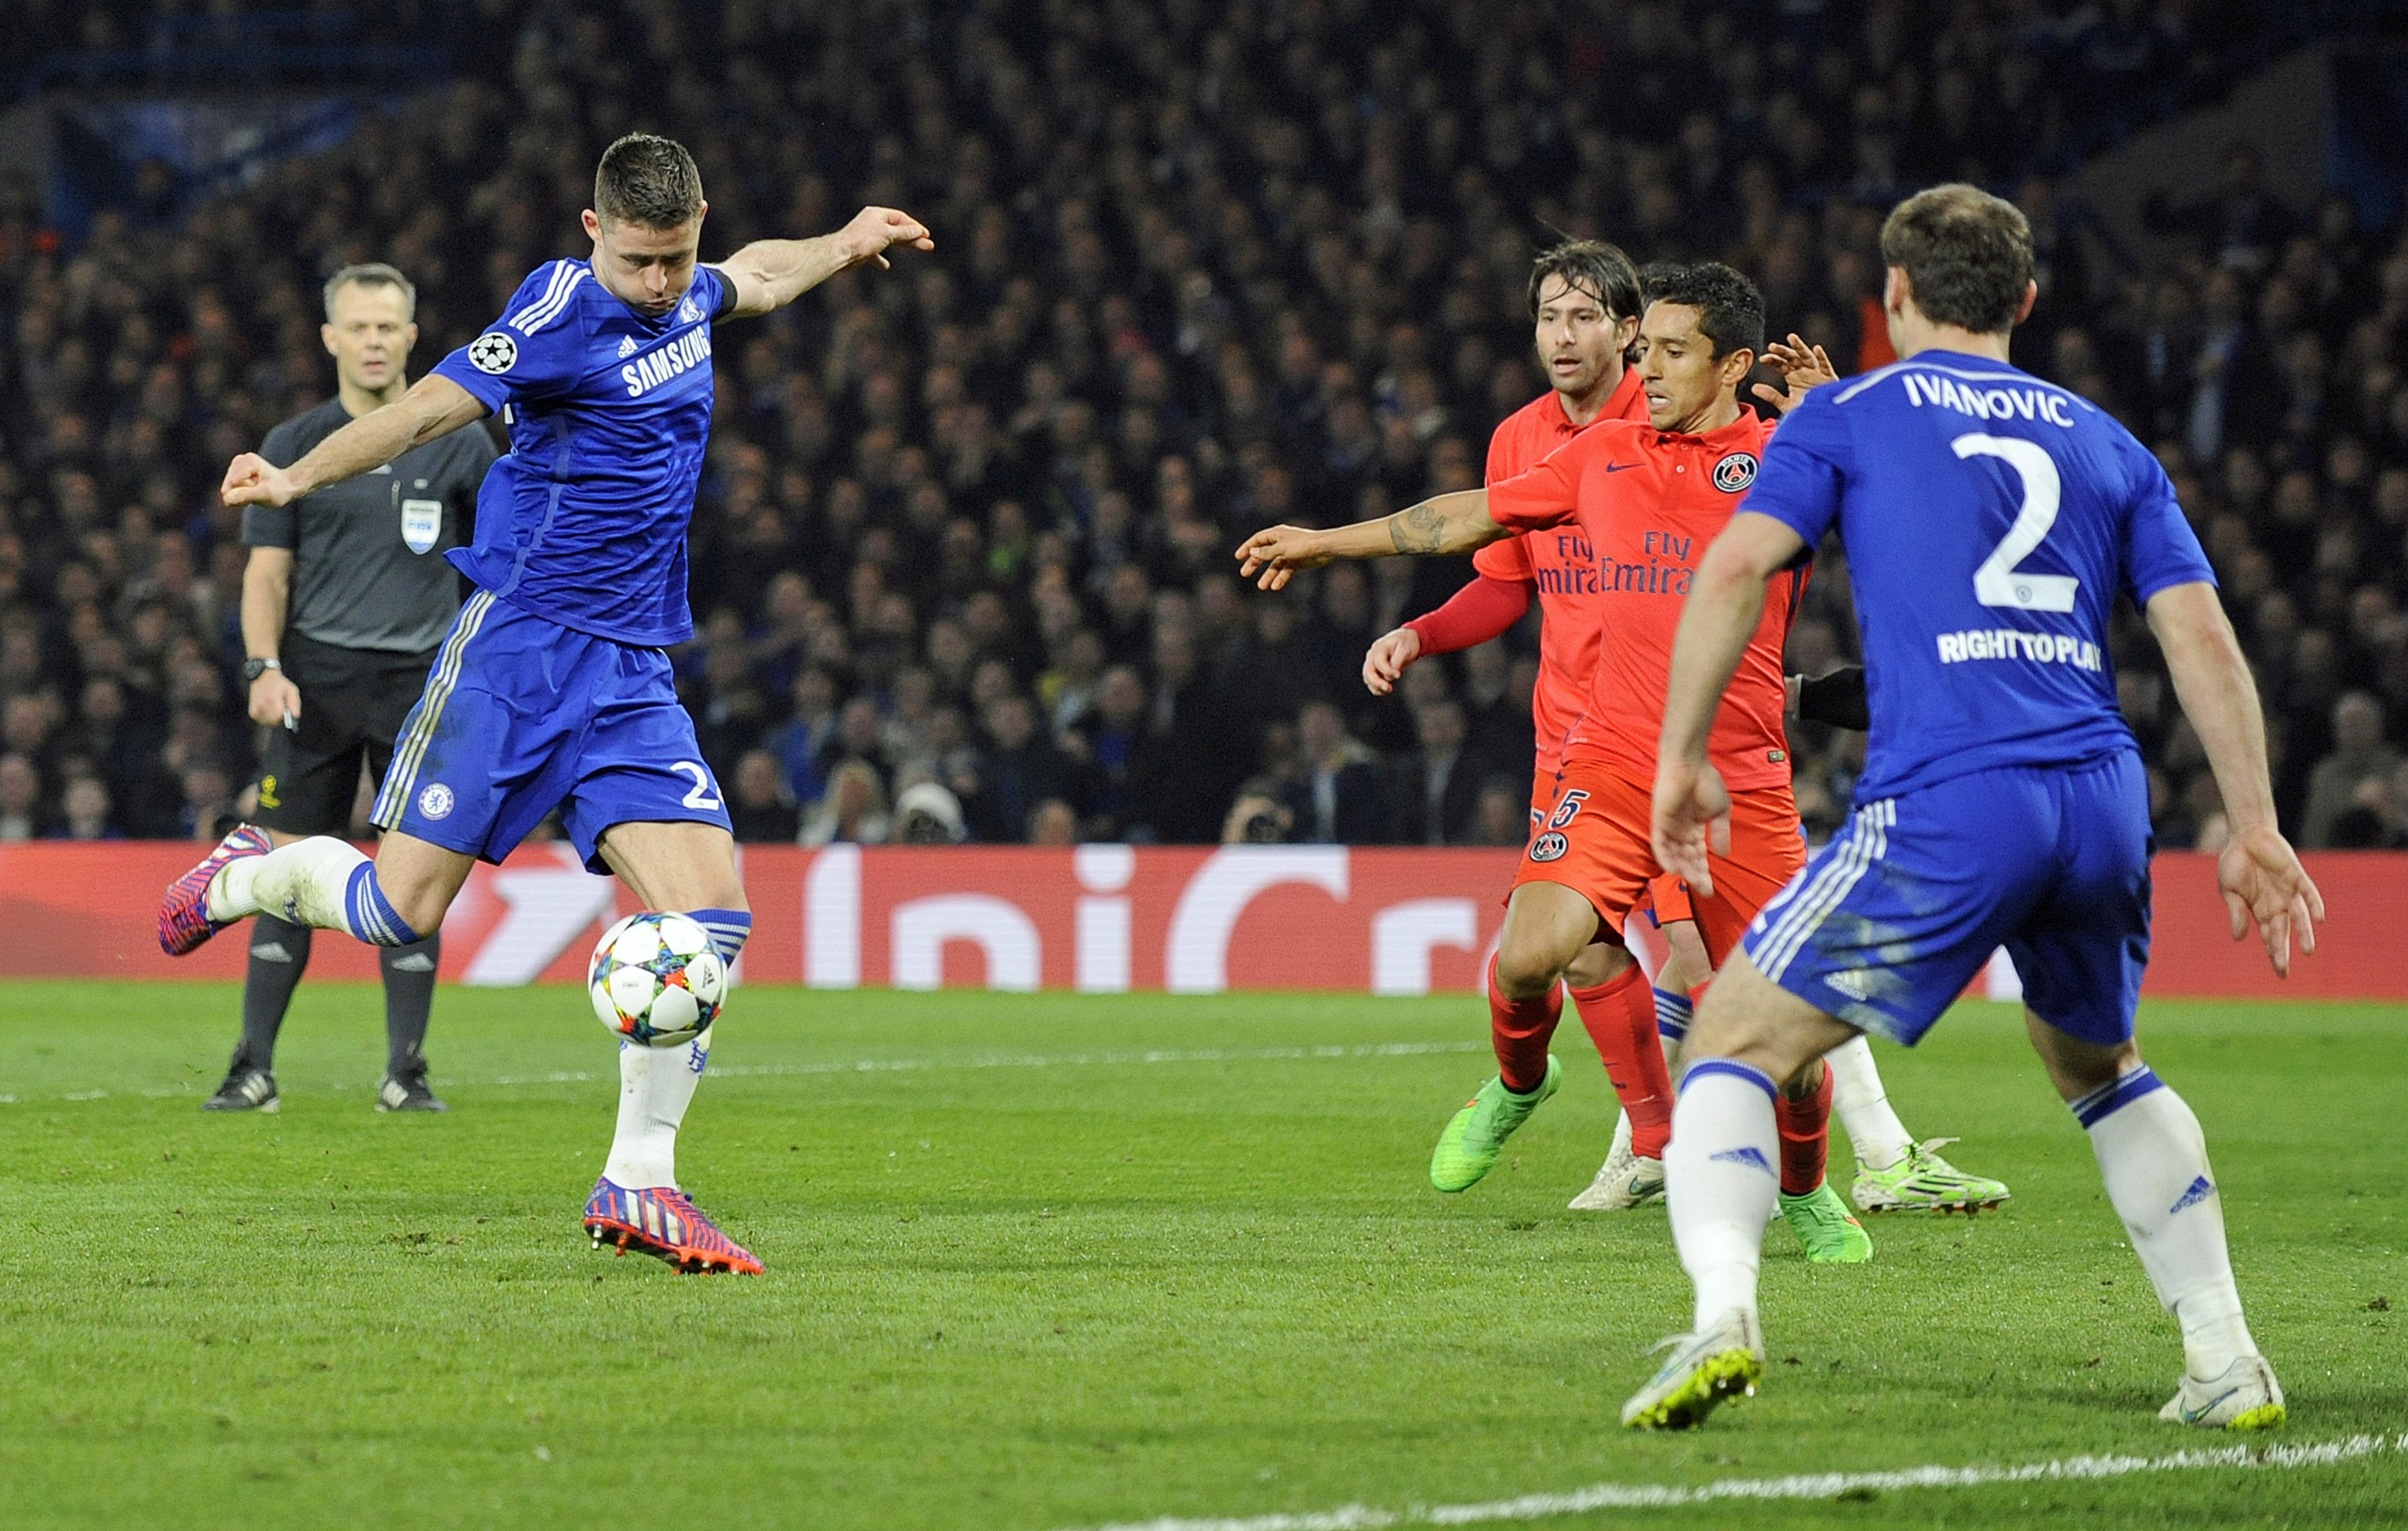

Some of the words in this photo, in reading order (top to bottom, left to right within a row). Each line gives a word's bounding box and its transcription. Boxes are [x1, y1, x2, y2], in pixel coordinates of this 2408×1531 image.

[621, 326, 712, 397] SAMSUNG
[1902, 373, 2075, 429] IVANOVIC
[1950, 432, 2080, 613] 2
[1558, 535, 1594, 562] Fly
[1644, 531, 1691, 561] Fly
[1537, 560, 1599, 594] mira
[1601, 556, 1695, 595] Emira
[1937, 629, 2018, 664] RIGHT
[2018, 632, 2055, 663] TO
[670, 761, 725, 811] 2
[1548, 788, 1590, 830] 5
